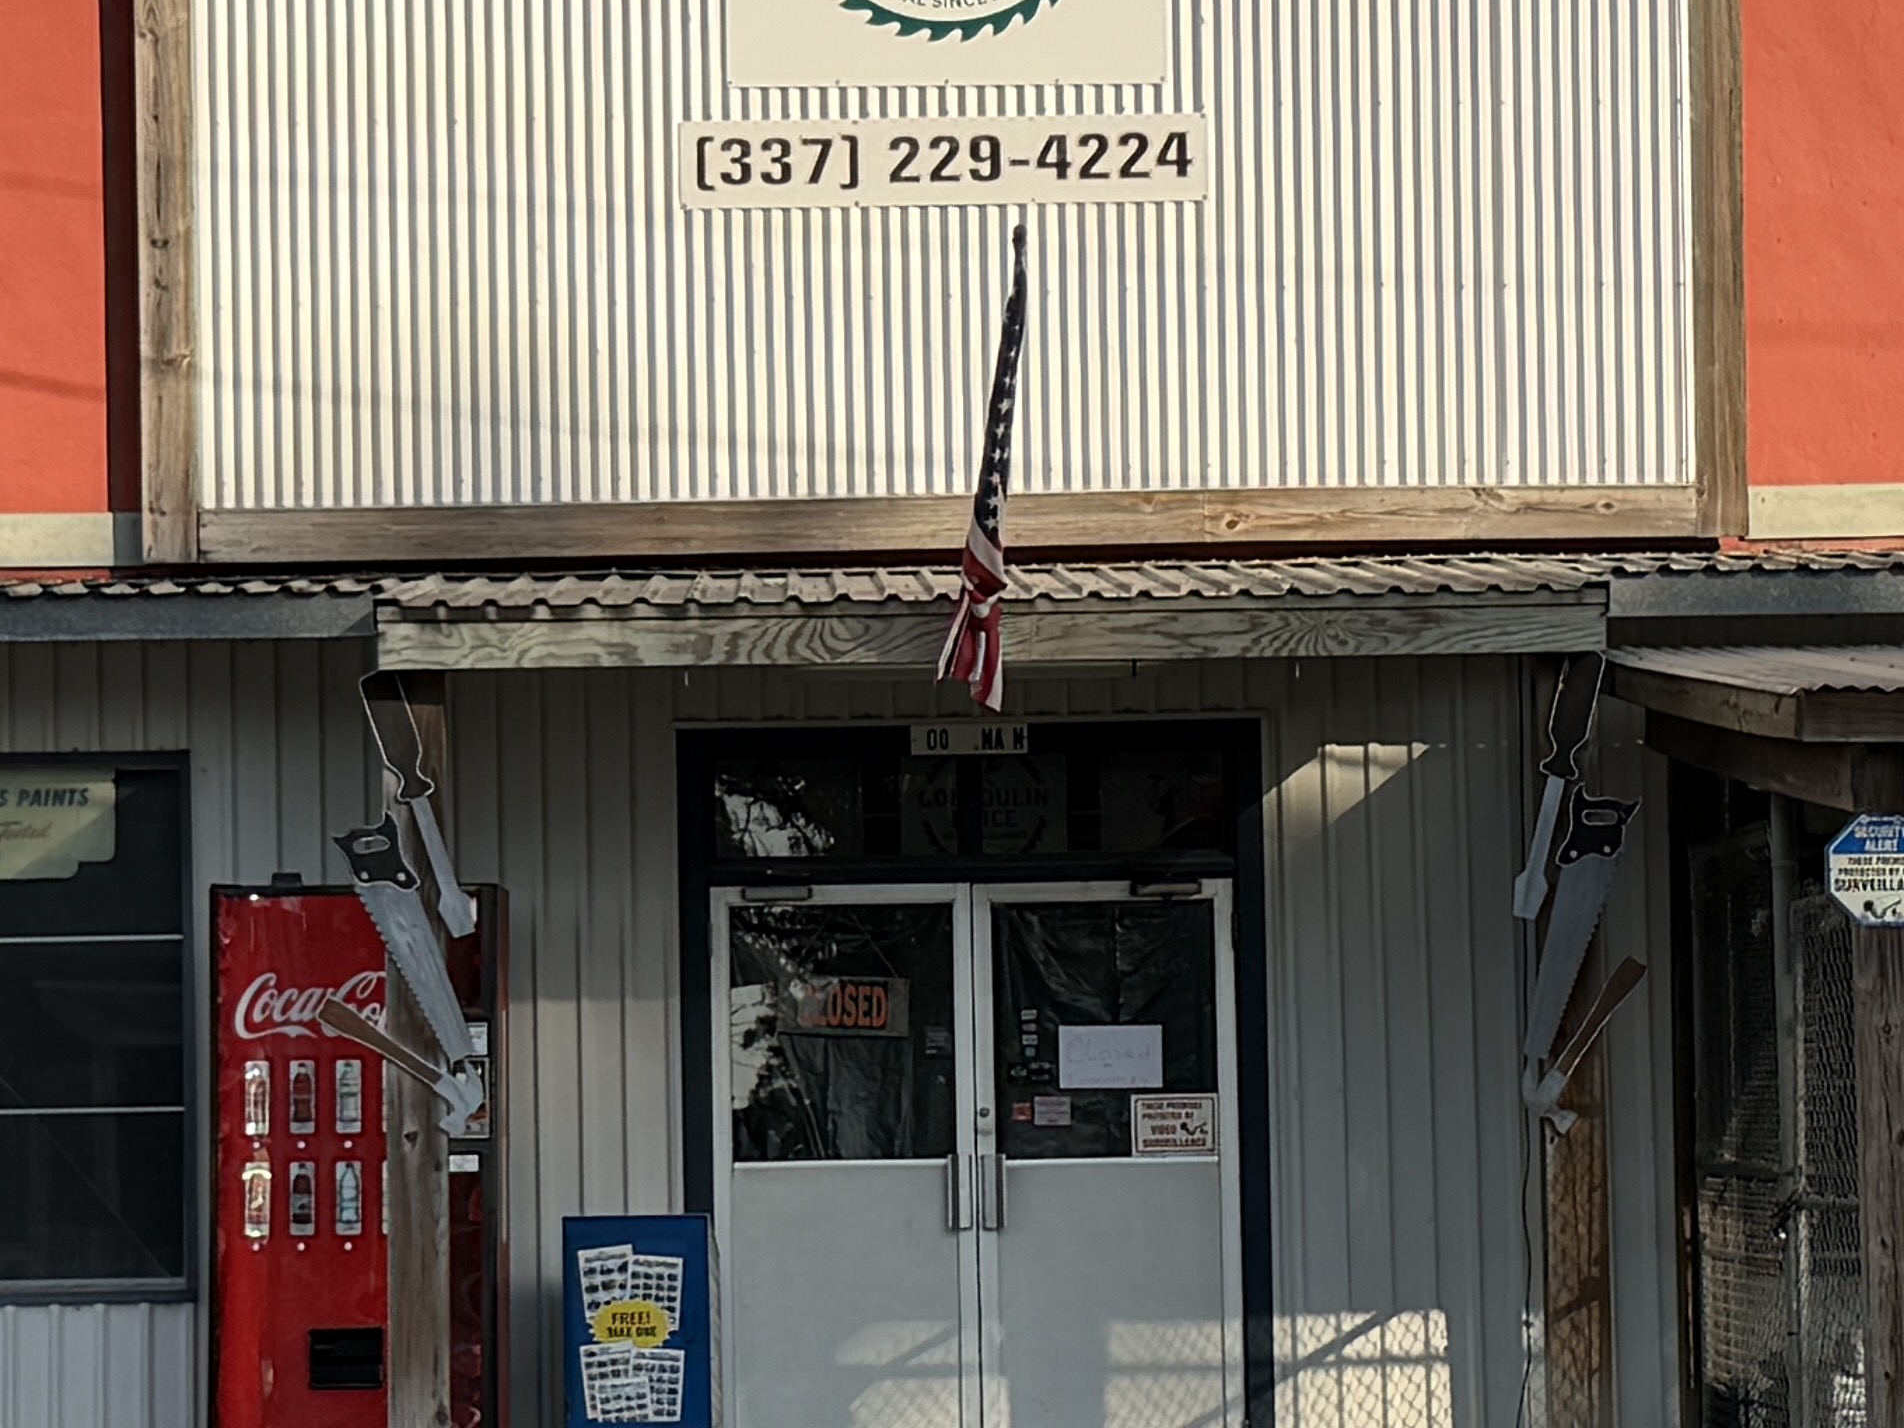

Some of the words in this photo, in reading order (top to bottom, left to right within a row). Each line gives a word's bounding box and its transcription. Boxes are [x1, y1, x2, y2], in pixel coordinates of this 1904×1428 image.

[888, 131, 1194, 184] 229-4224
[17, 787, 90, 808] PAINTS
[797, 983, 887, 1028] CLOSED
[611, 1311, 651, 1325] FREE!
